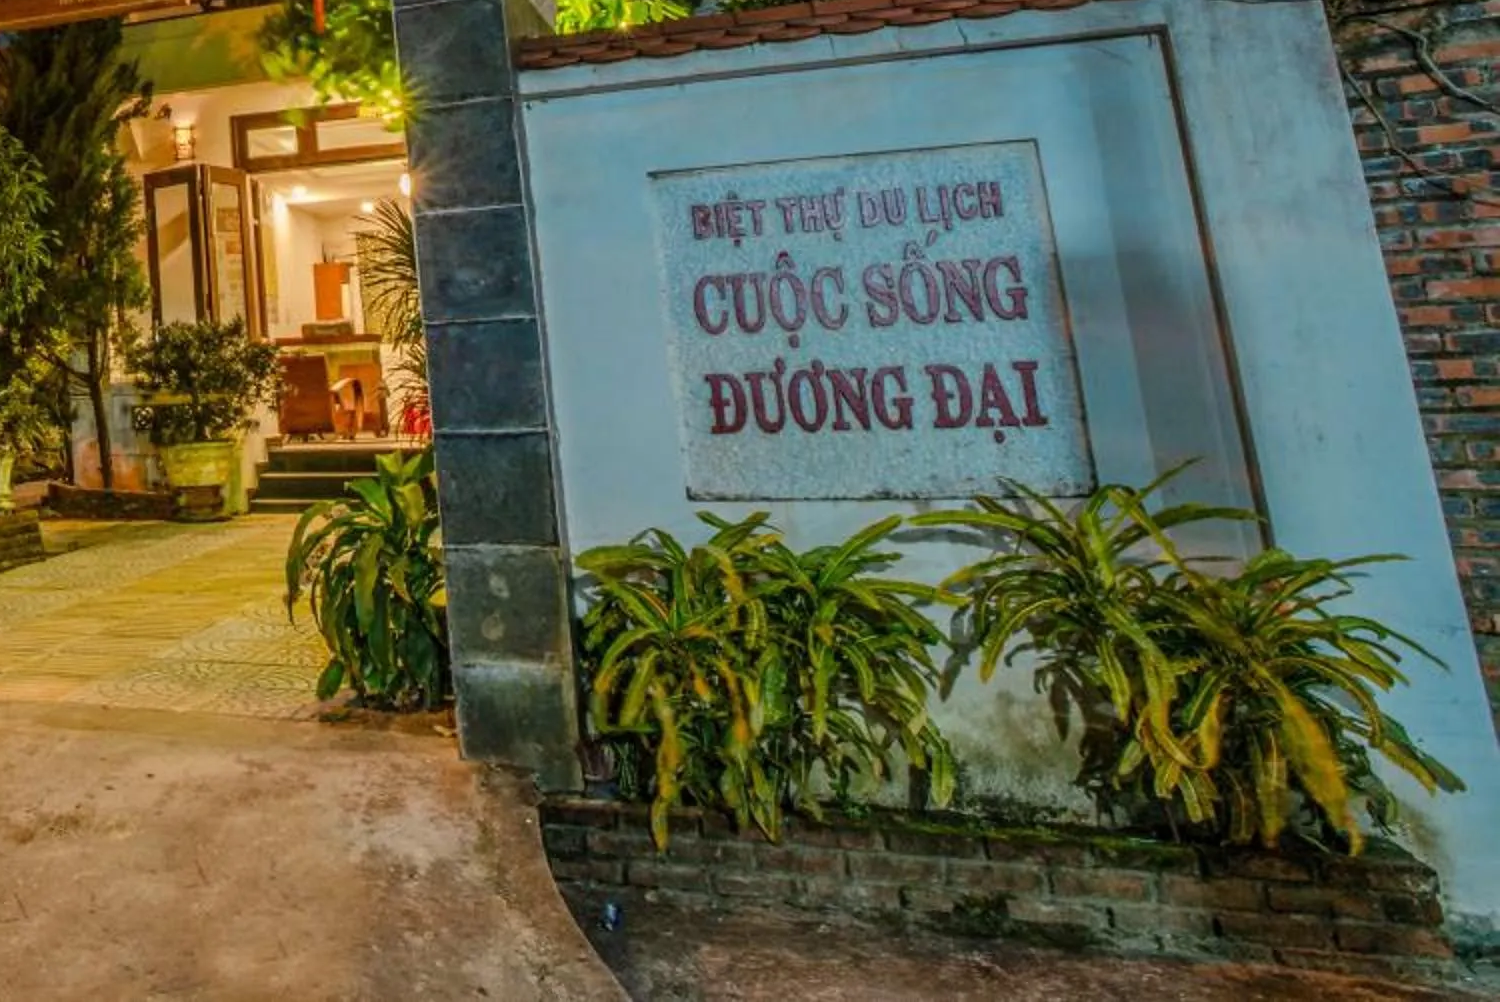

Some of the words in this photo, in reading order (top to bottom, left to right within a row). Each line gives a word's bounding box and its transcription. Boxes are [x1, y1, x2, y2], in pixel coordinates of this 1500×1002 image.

[691, 190, 765, 246] BIỆT
[856, 185, 907, 229] DU
[915, 180, 1005, 232] LỊCH
[692, 251, 848, 349] CUỘC
[861, 229, 1030, 328] SỐNG
[703, 357, 915, 435] ĐƯƠNG
[924, 360, 1049, 444] ĐẠI
